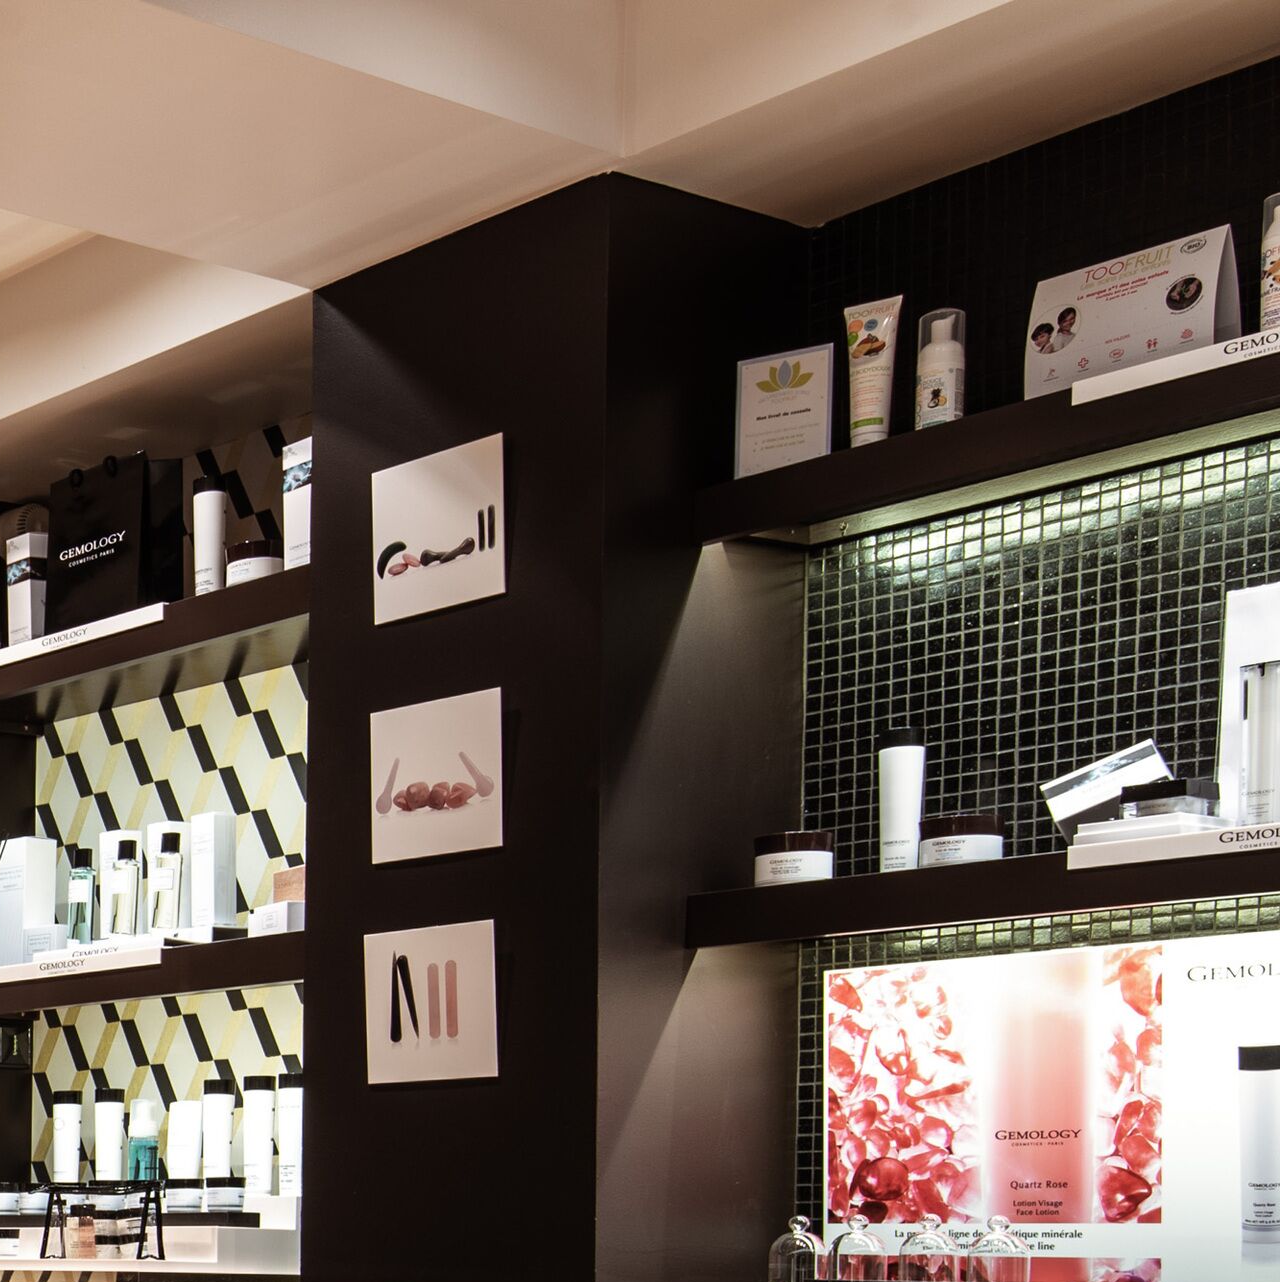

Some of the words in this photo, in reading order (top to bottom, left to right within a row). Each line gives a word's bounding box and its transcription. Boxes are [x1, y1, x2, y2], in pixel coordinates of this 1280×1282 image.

[1084, 245, 1175, 284] TOOFRUIT
[59, 530, 126, 561] GEMOLOGY
[68, 553, 98, 568] COSMETICS
[99, 548, 115, 557] PARIS
[41, 627, 88, 646] GEMOLOGY
[40, 959, 86, 971] GEMOLOGY
[995, 1129, 1082, 1141] GEMOLOGY
[1010, 1180, 1042, 1190] Quartz
[1045, 1180, 1068, 1189] Rose
[1038, 1200, 1063, 1209] Visage
[895, 1230, 904, 1238] La
[948, 1229, 970, 1239] ligne
[972, 1230, 983, 1238] de
[1041, 1229, 1083, 1238] minérale
[1037, 1241, 1055, 1250] line
